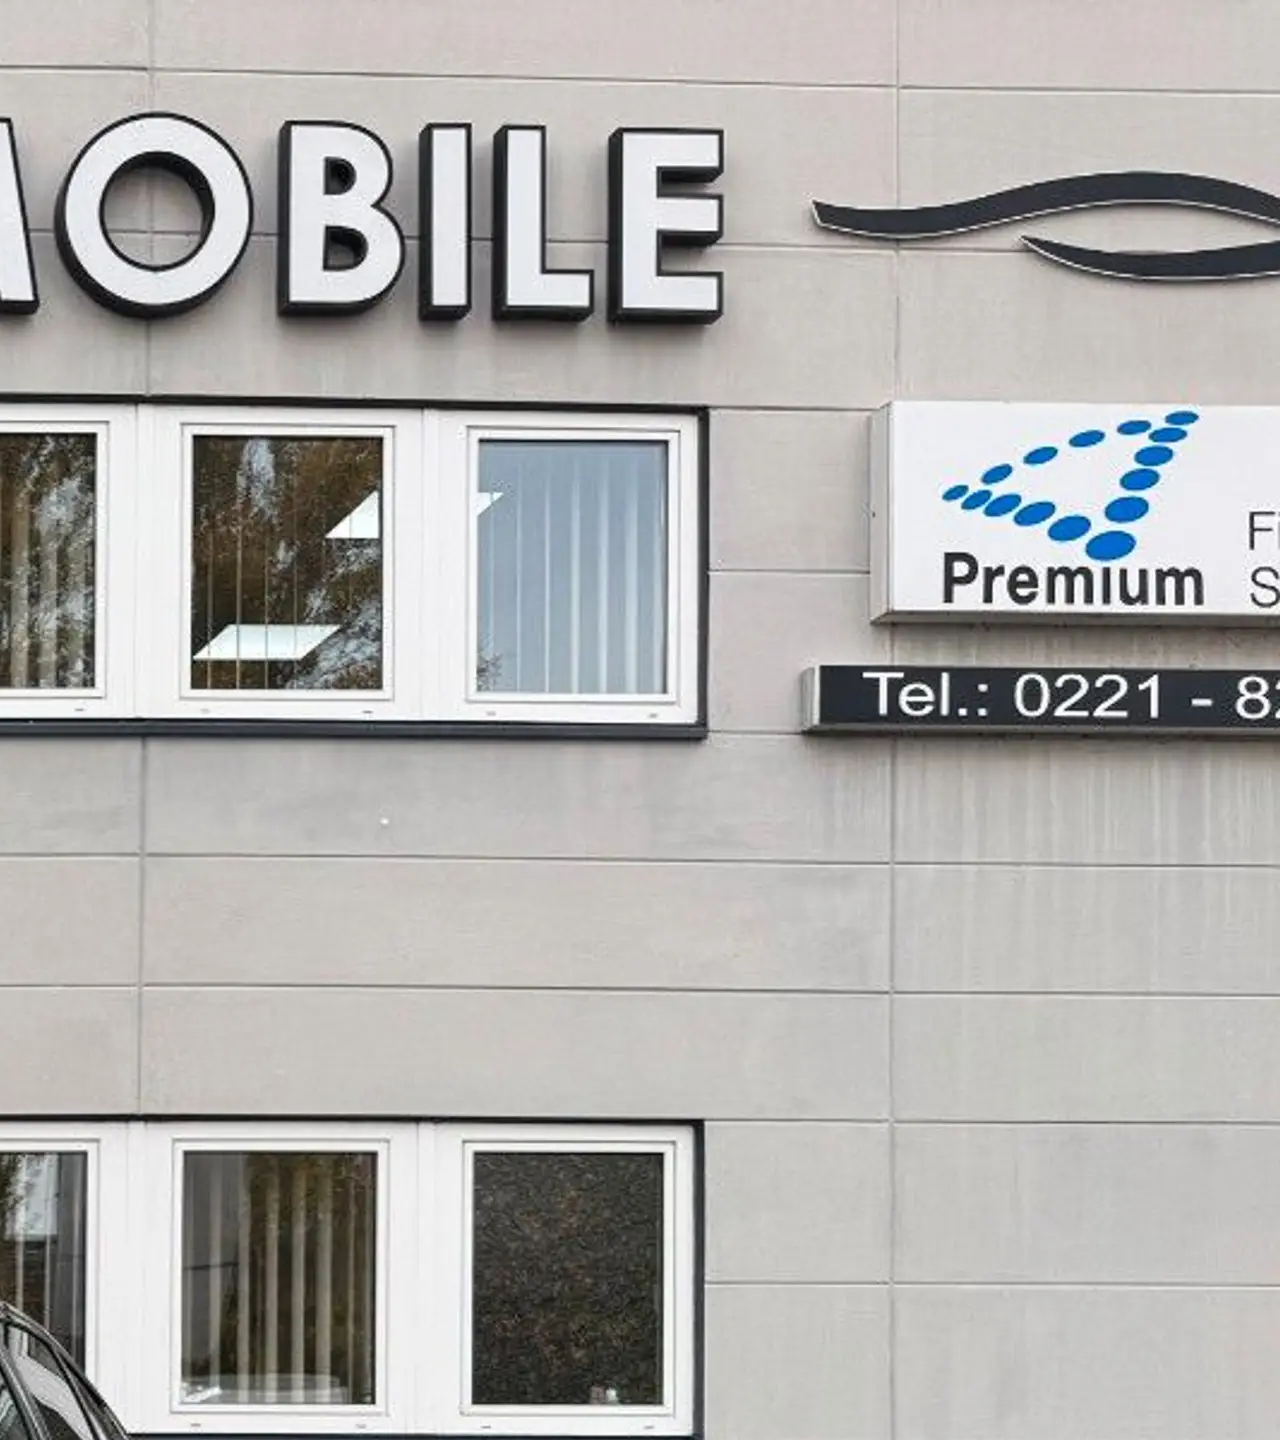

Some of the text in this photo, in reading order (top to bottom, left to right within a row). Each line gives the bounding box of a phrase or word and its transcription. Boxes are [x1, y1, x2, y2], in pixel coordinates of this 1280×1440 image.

[1248, 511, 1280, 550] F
[942, 552, 1205, 606] Premium
[861, 670, 988, 717] Tel.:
[1014, 673, 1162, 719] 0221
[1235, 674, 1280, 720] 8
